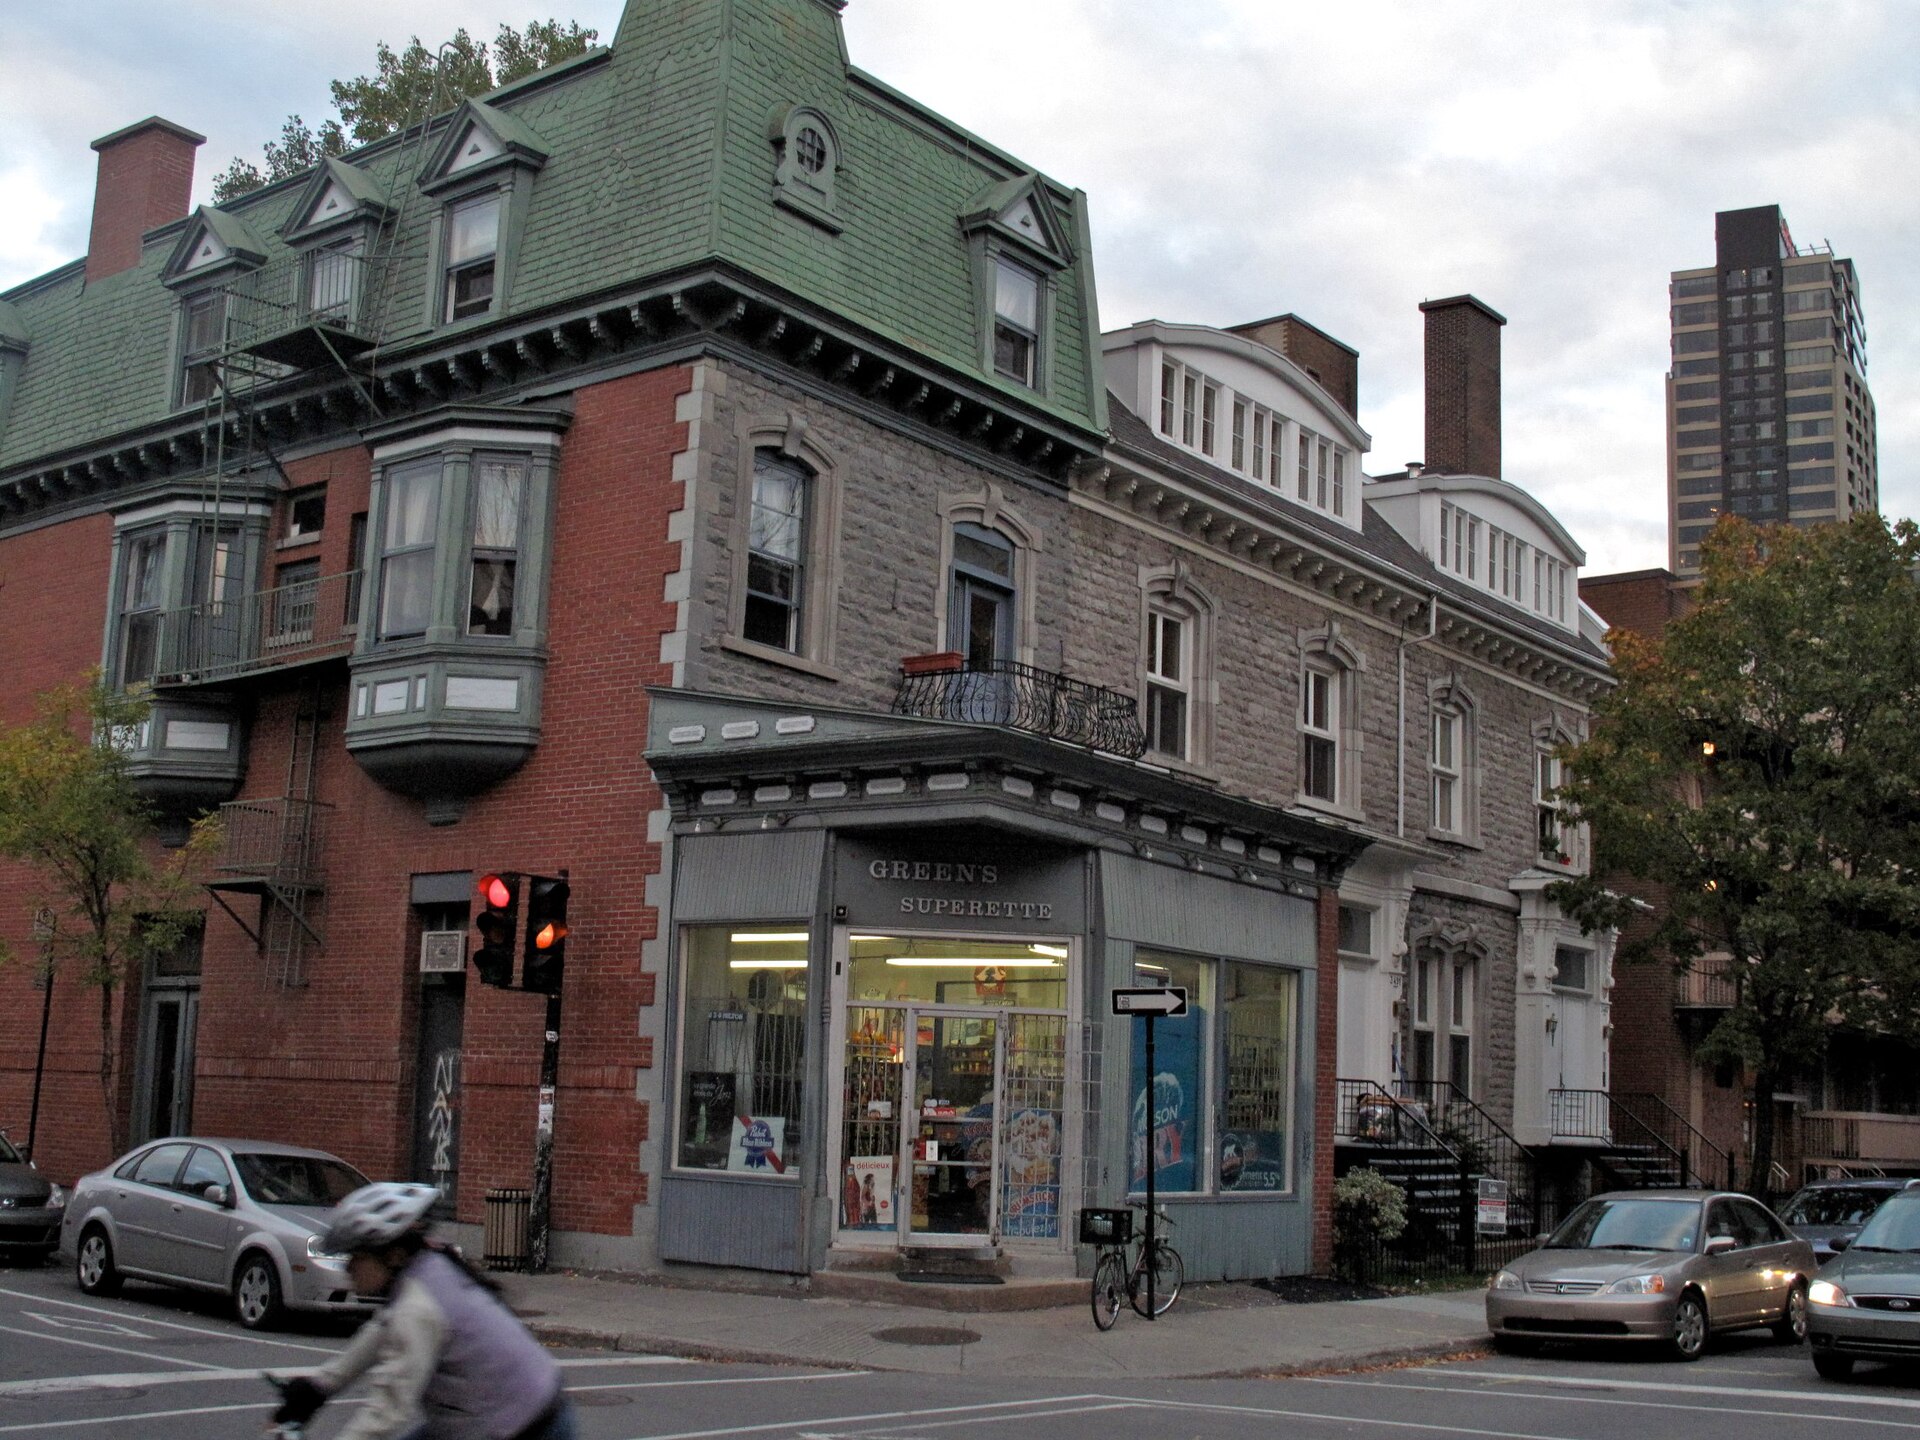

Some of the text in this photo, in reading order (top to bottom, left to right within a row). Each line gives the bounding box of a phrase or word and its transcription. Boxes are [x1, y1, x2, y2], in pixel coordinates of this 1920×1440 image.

[869, 859, 998, 883] GREEN'S
[900, 897, 1052, 919] SUPERETTE
[1137, 1105, 1178, 1133] MSON
